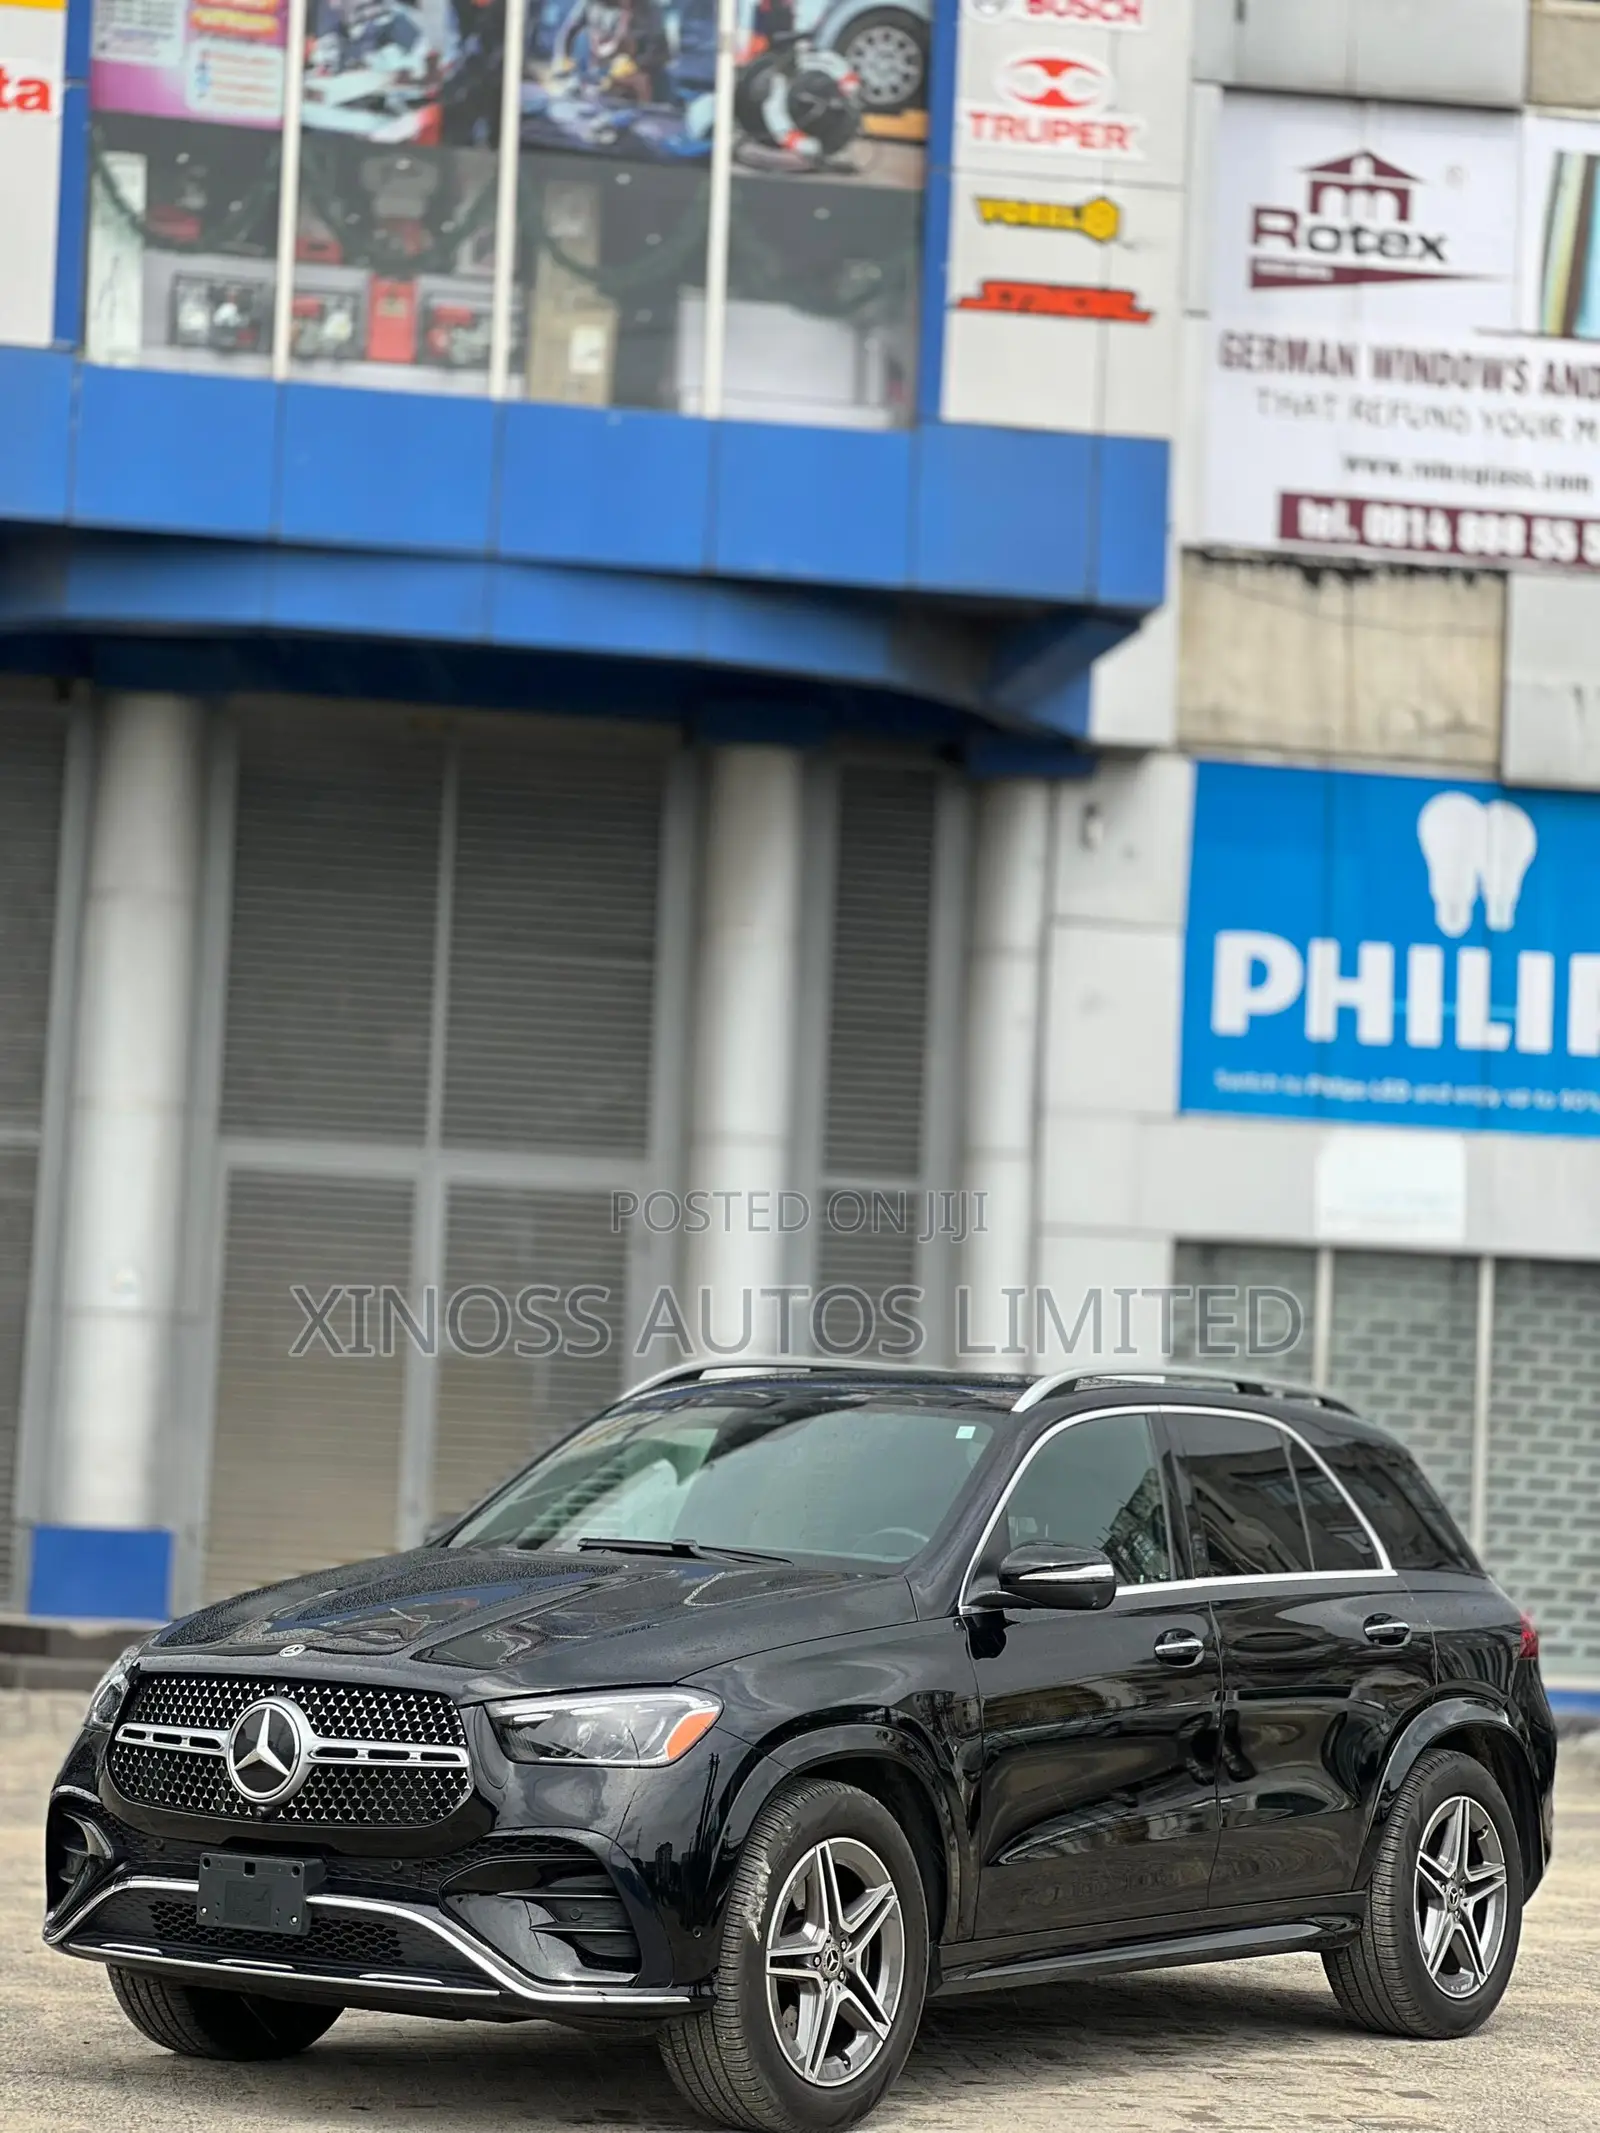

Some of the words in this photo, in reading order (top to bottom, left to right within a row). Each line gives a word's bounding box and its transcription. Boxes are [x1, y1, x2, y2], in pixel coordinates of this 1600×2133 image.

[969, 111, 1129, 152] TRUPER
[1251, 206, 1448, 263] Rotex
[1219, 330, 1356, 377] GERMAN
[1370, 346, 1529, 395] WINDOWS
[1257, 386, 1338, 422] THAT
[1349, 396, 1472, 435] REFUND
[1480, 406, 1565, 441] YOUR
